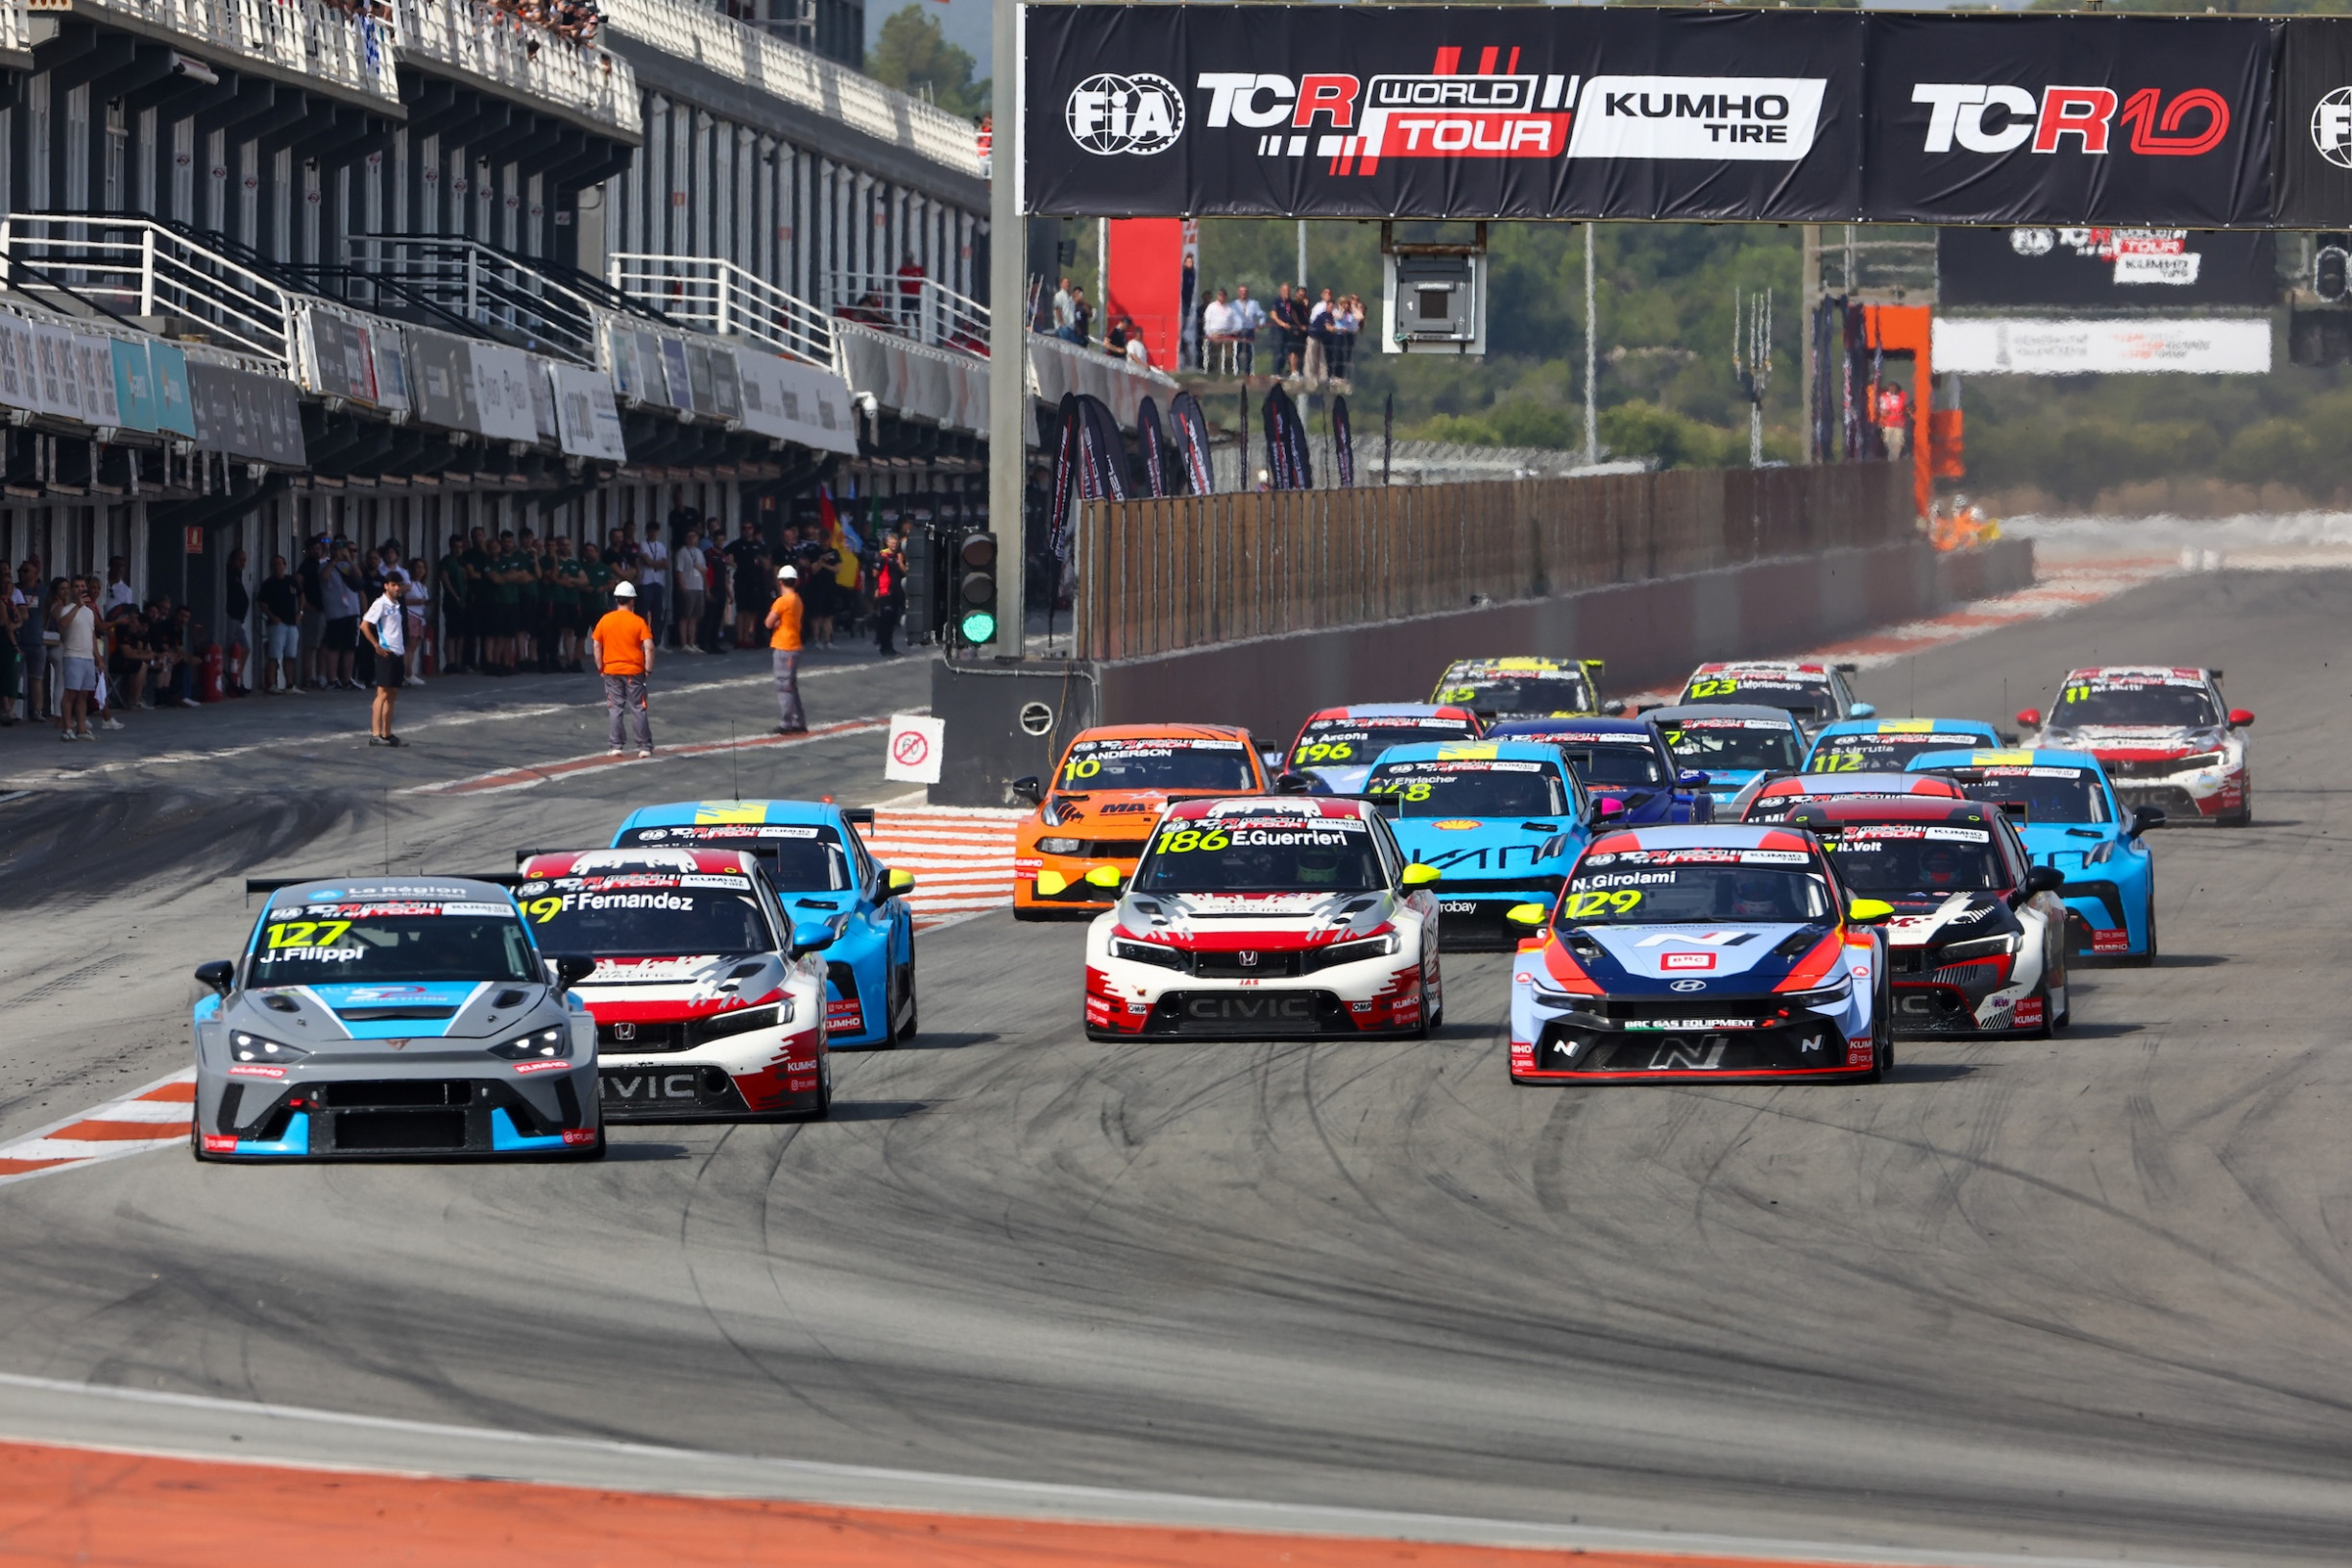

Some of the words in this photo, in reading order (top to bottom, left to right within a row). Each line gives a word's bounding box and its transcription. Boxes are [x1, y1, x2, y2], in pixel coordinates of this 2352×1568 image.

[1197, 73, 1360, 128] TCR
[1380, 82, 1519, 104] WORLD
[1605, 92, 1789, 121] KUMHO
[1398, 120, 1552, 151] TOUR
[1704, 124, 1787, 143] TIRE
[1690, 679, 1737, 699] 123
[2066, 686, 2090, 704] 11
[1320, 733, 1368, 742] Azcona
[1295, 742, 1352, 765] 196
[1814, 754, 1865, 772] 112
[1064, 760, 1101, 782] 10
[1155, 830, 1229, 855] 186
[1231, 831, 1348, 846] E.Guerrieri
[1934, 829, 1982, 837] KUMHO
[1571, 871, 1677, 892] N.Girolami
[562, 894, 576, 911] F
[578, 892, 693, 911] Fernandez
[1441, 902, 1476, 918] robay
[1564, 890, 1642, 919] 129
[267, 920, 352, 949] 127
[1189, 999, 1309, 1018] CIVIC
[1653, 1020, 1680, 1028] GAS
[1683, 1019, 1756, 1027] EQUIPMENT
[1512, 1045, 1533, 1054] MHO
[1850, 1041, 1873, 1049] KUM
[516, 1061, 569, 1073] KUMHO
[598, 1074, 695, 1098] IVIC
